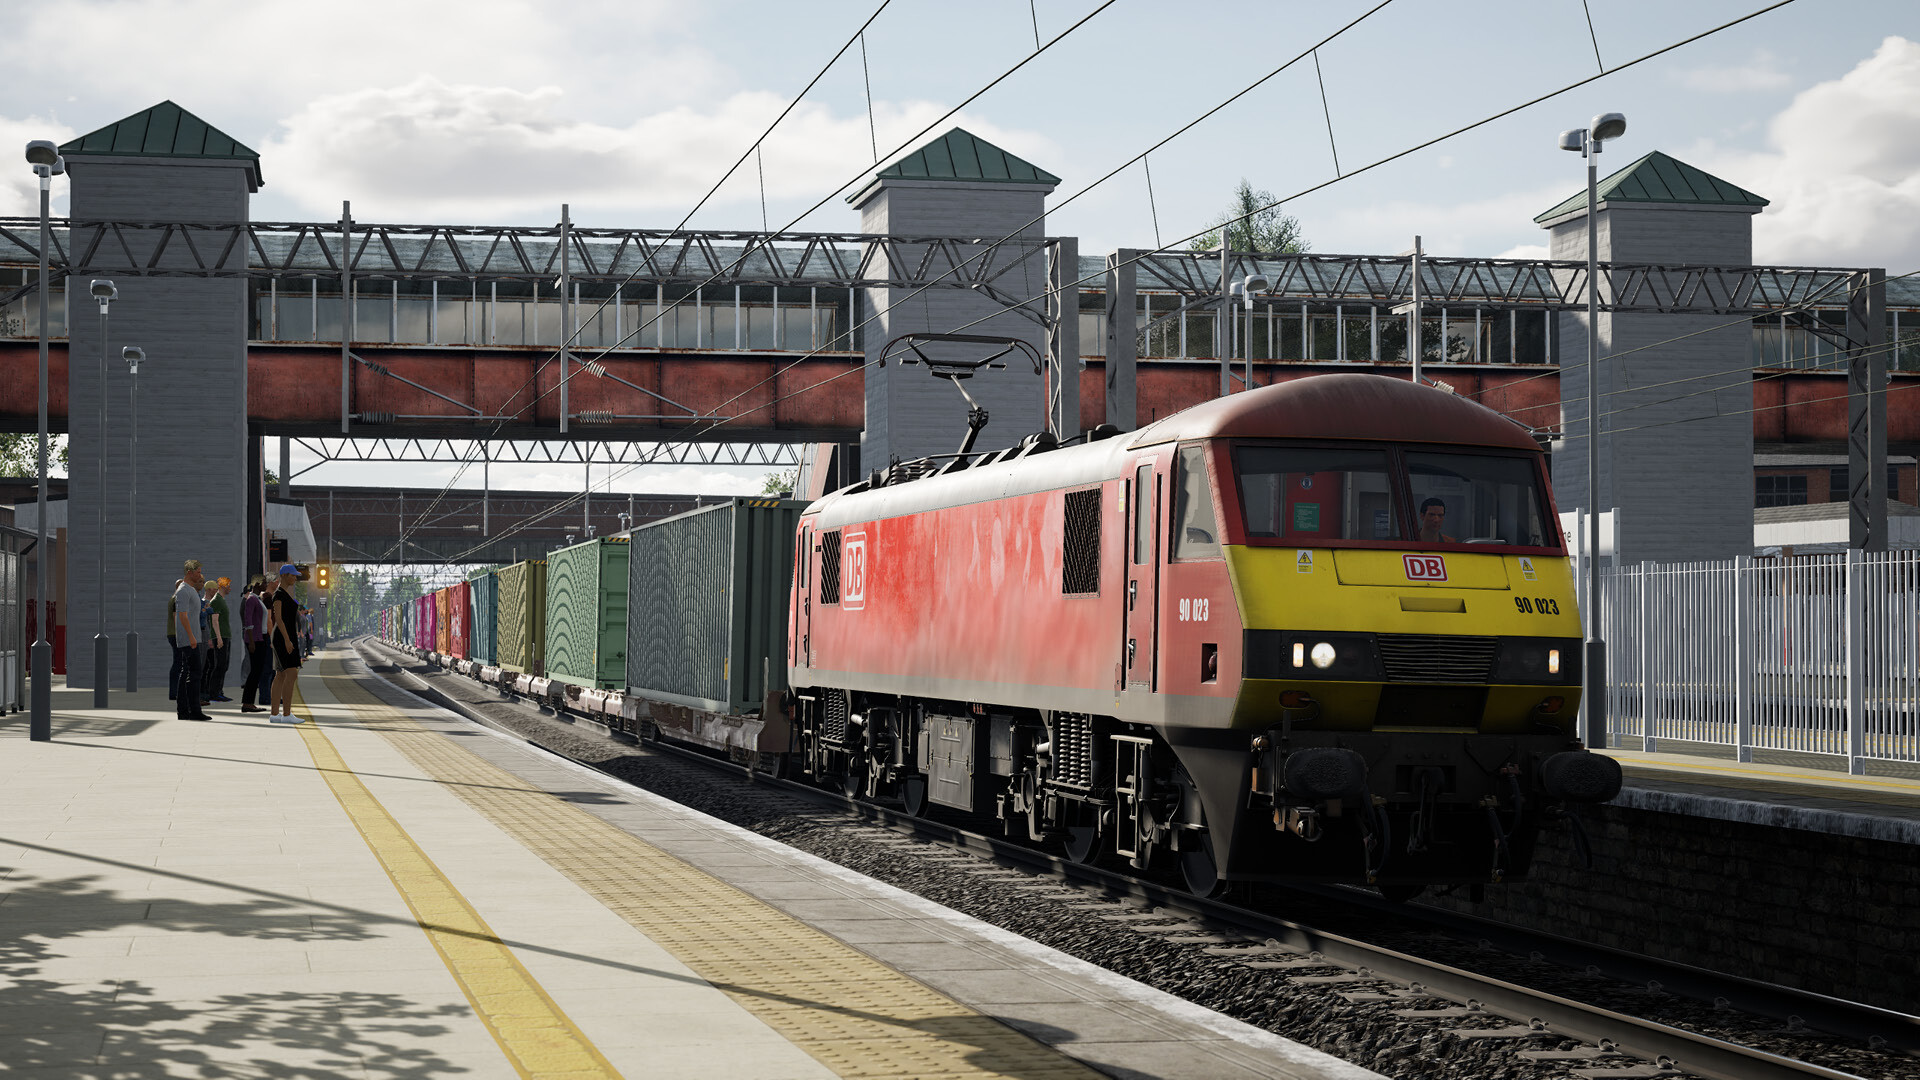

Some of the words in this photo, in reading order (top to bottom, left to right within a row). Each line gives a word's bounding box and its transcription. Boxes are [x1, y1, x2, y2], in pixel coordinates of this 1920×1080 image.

[845, 545, 864, 597] DB
[1407, 557, 1443, 577] DB
[1179, 598, 1190, 622] 90
[1192, 598, 1209, 622] 023
[1514, 596, 1534, 614] 90
[1534, 597, 1560, 616] 023
